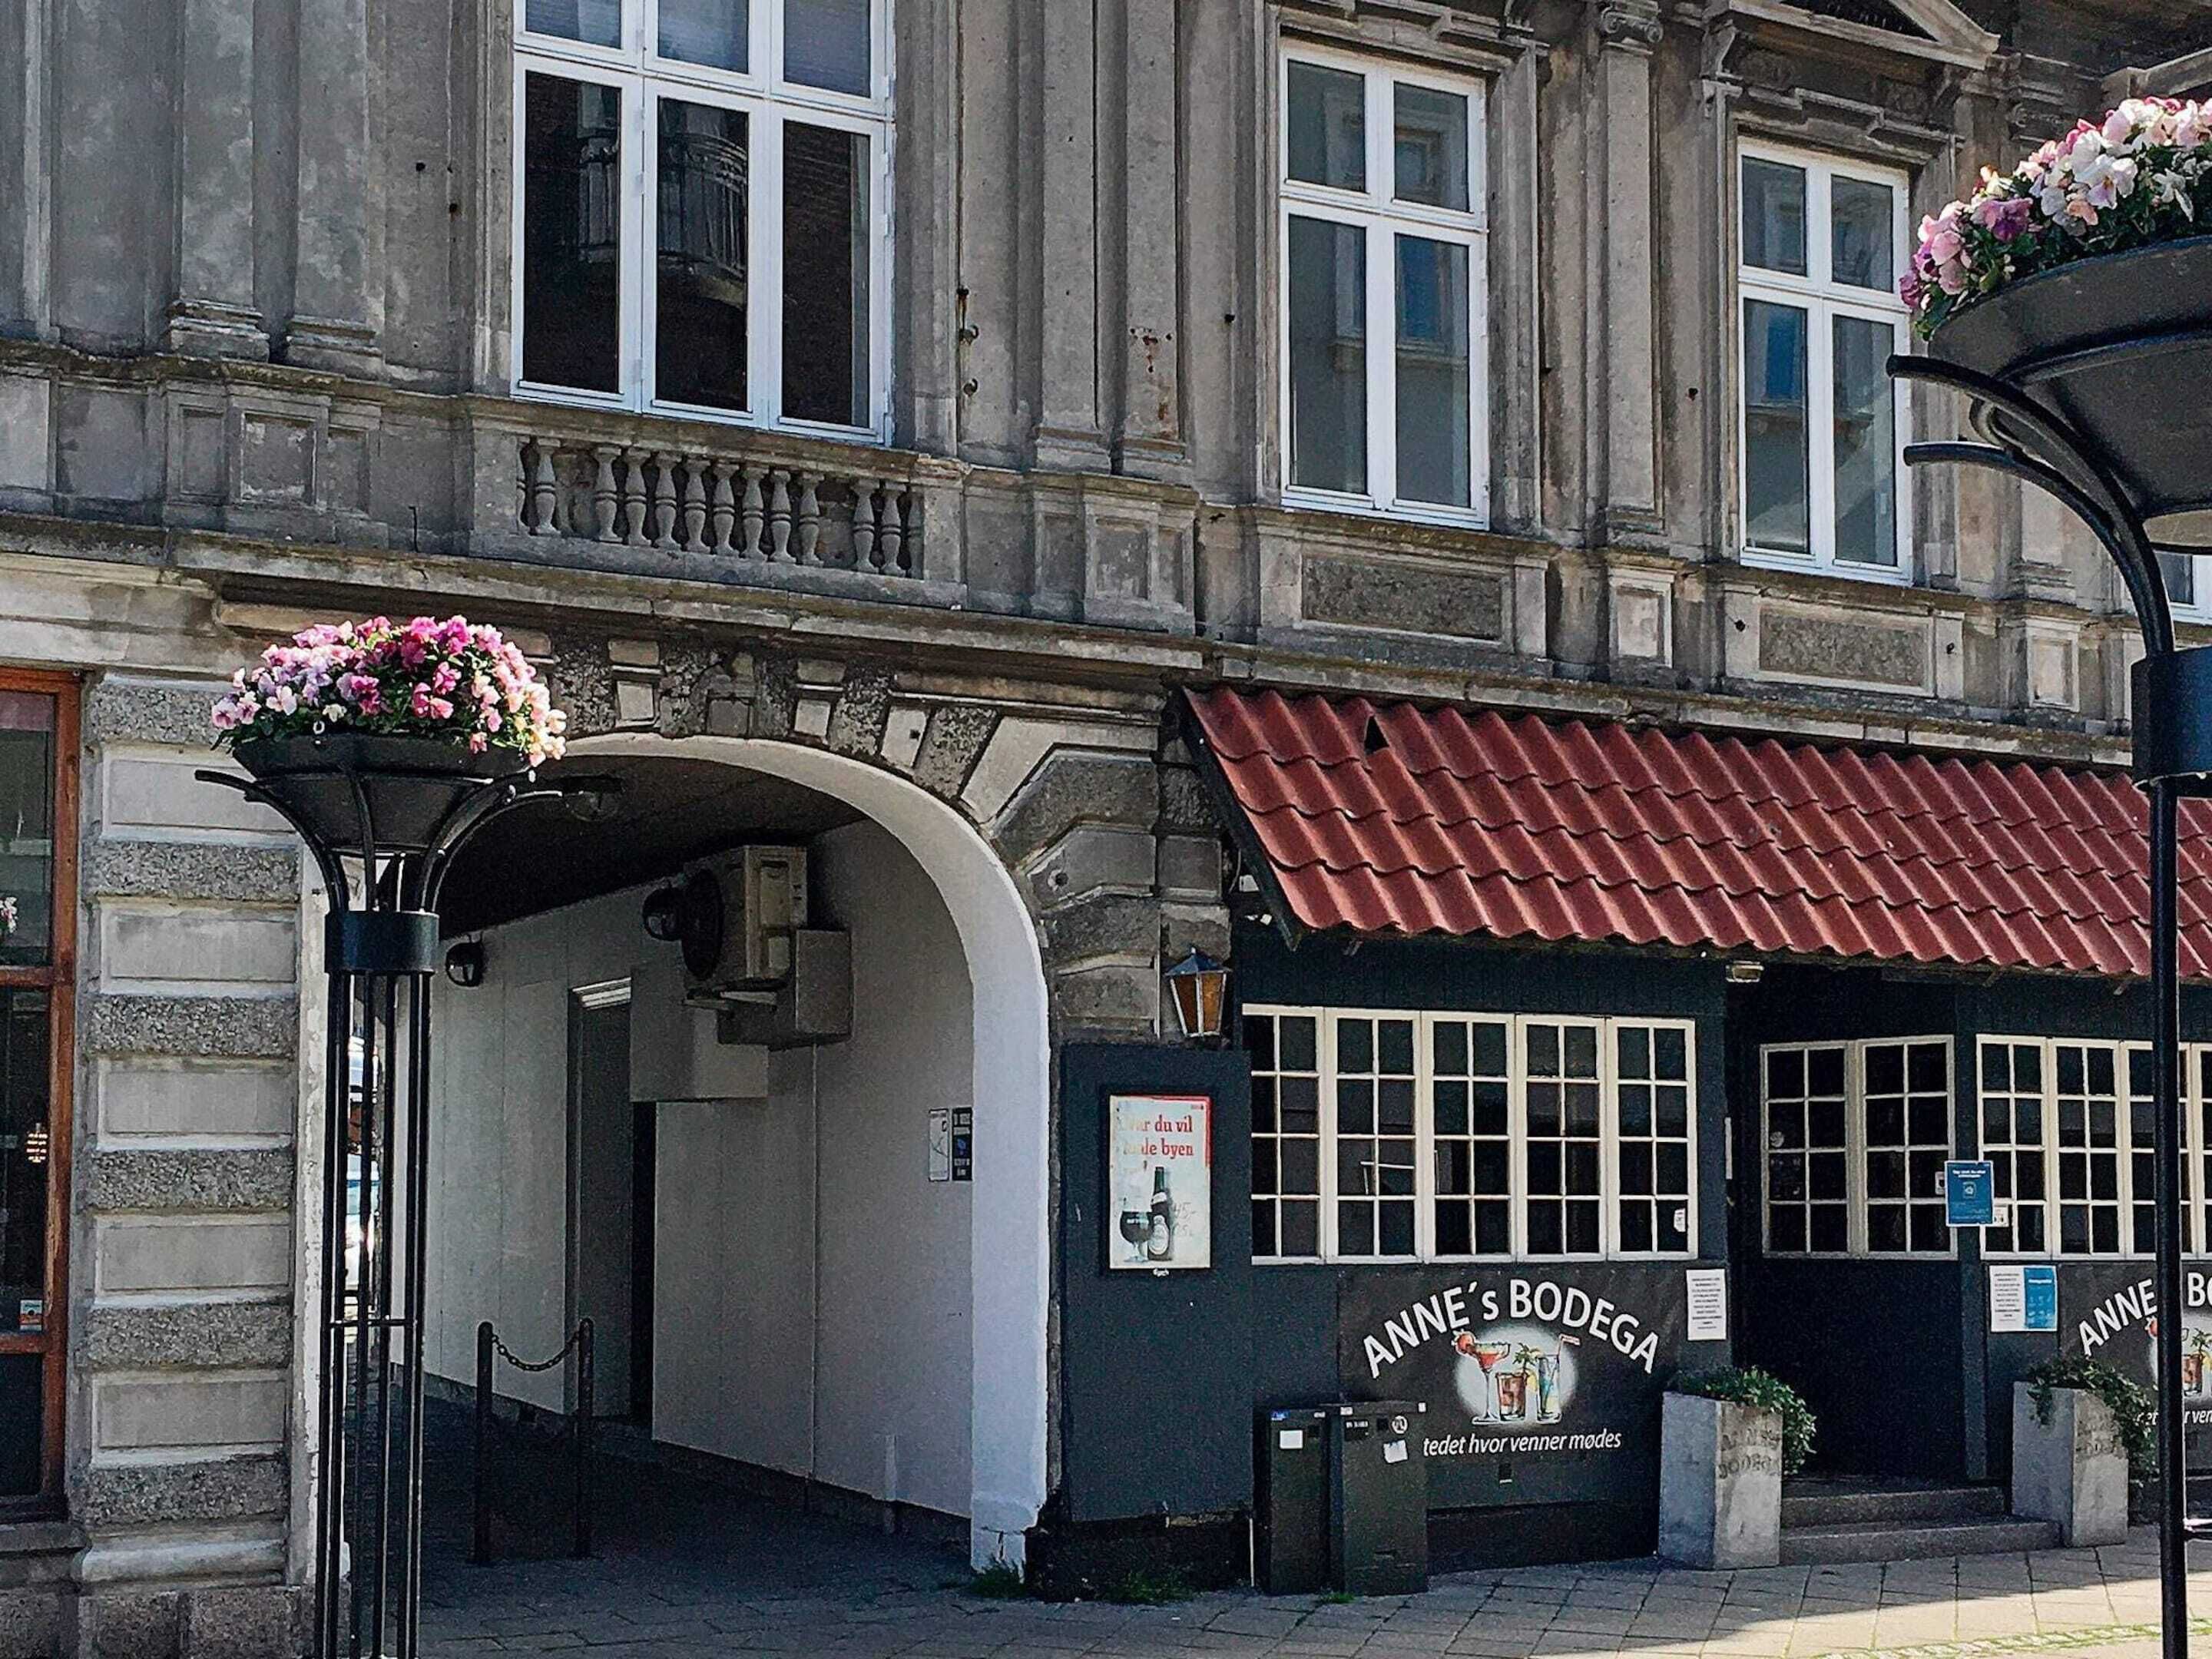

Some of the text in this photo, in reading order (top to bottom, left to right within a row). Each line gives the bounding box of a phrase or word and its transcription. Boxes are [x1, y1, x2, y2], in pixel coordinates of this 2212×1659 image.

[1154, 1114, 1174, 1133] du
[1175, 1114, 1193, 1133] vil
[1161, 1137, 1194, 1160] byen
[1509, 1279, 1660, 1374] BODEGA
[2078, 1278, 2158, 1357] ANNE
[1423, 1428, 1622, 1457] tedet hvor venner mødes
